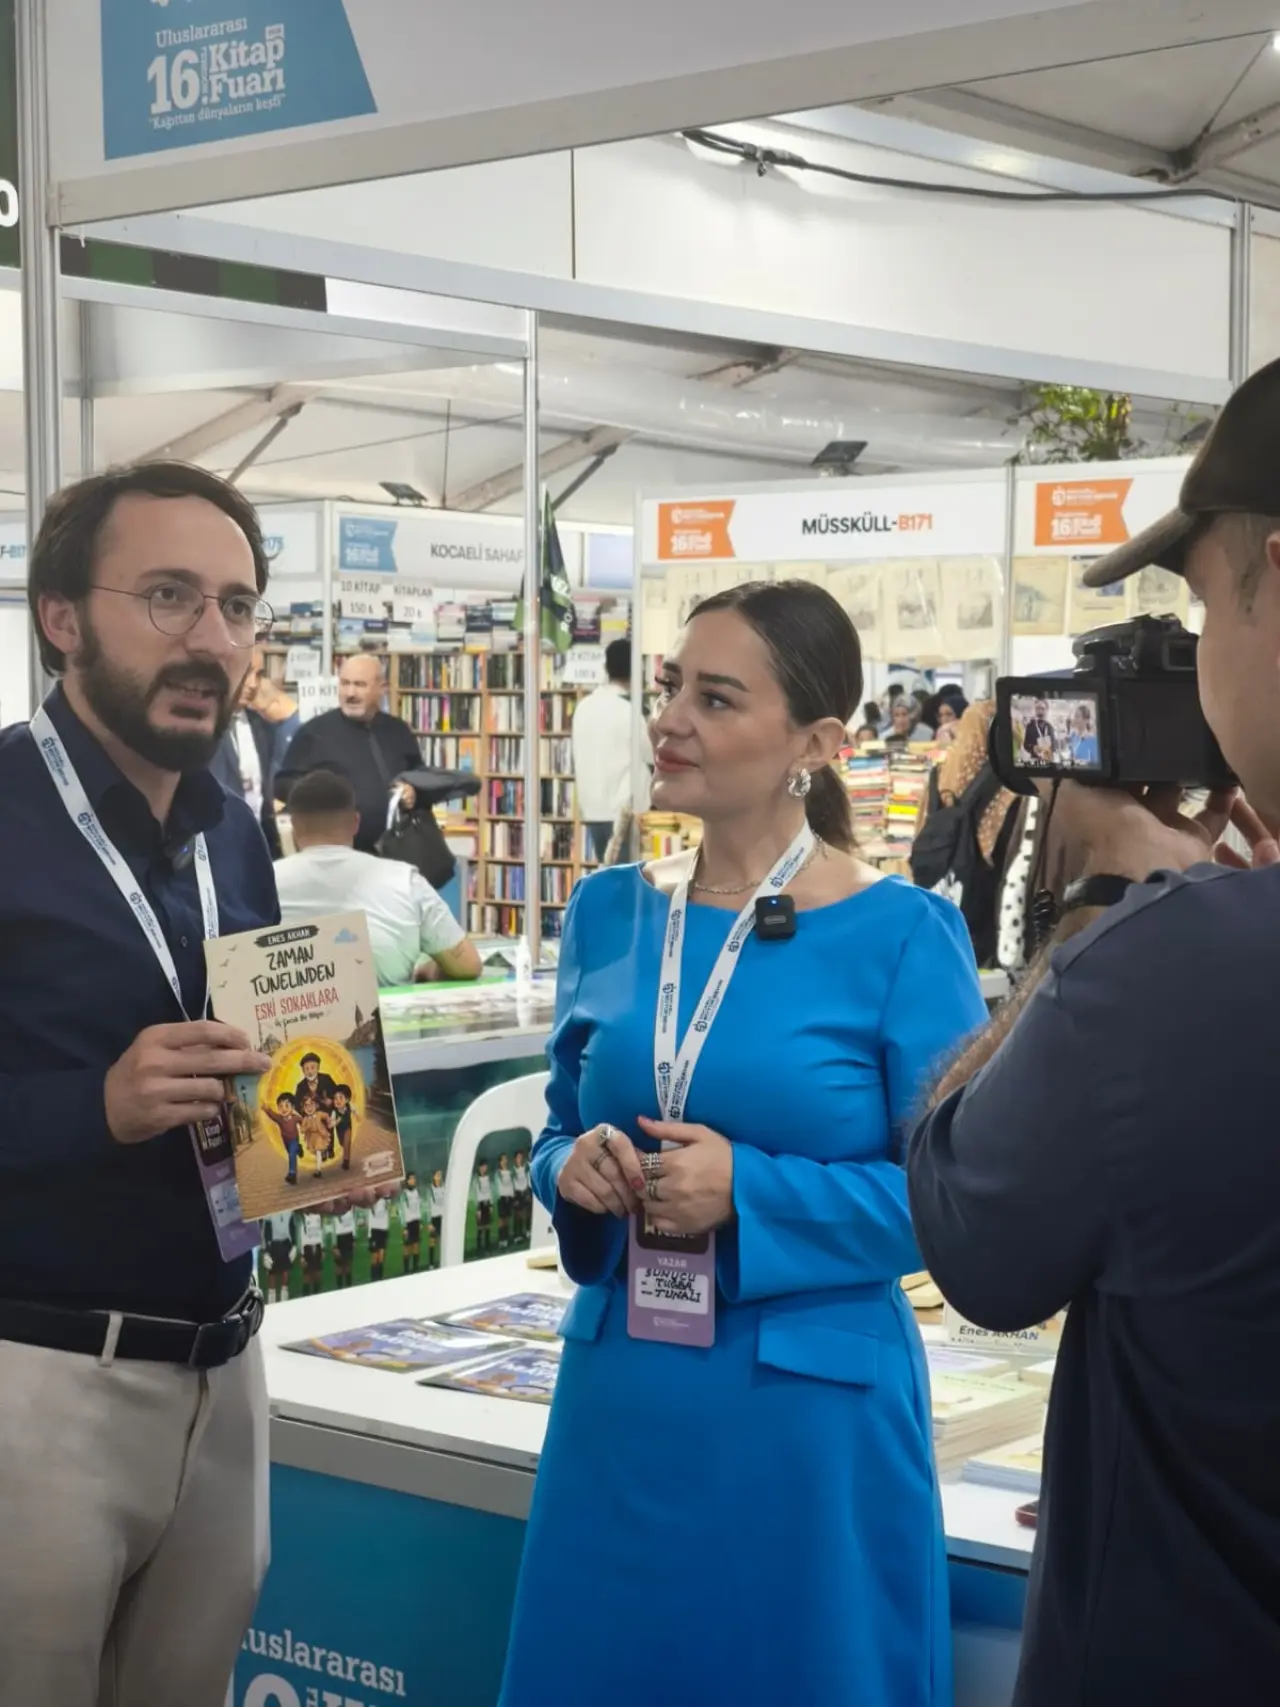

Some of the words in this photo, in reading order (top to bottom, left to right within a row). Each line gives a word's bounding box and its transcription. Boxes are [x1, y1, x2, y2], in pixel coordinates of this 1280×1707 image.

[156, 17, 248, 48] Uluslararası
[209, 39, 285, 73] Kitap
[209, 68, 286, 103] Fuarı
[802, 511, 933, 536] MÜSSKÜLL-B171
[430, 542, 483, 560] KOCAELİ
[265, 943, 315, 971] ZAMAN
[279, 986, 340, 1016] SOKAKLARA
[959, 1324, 989, 1337] Enes
[241, 1627, 407, 1697] uslararası
